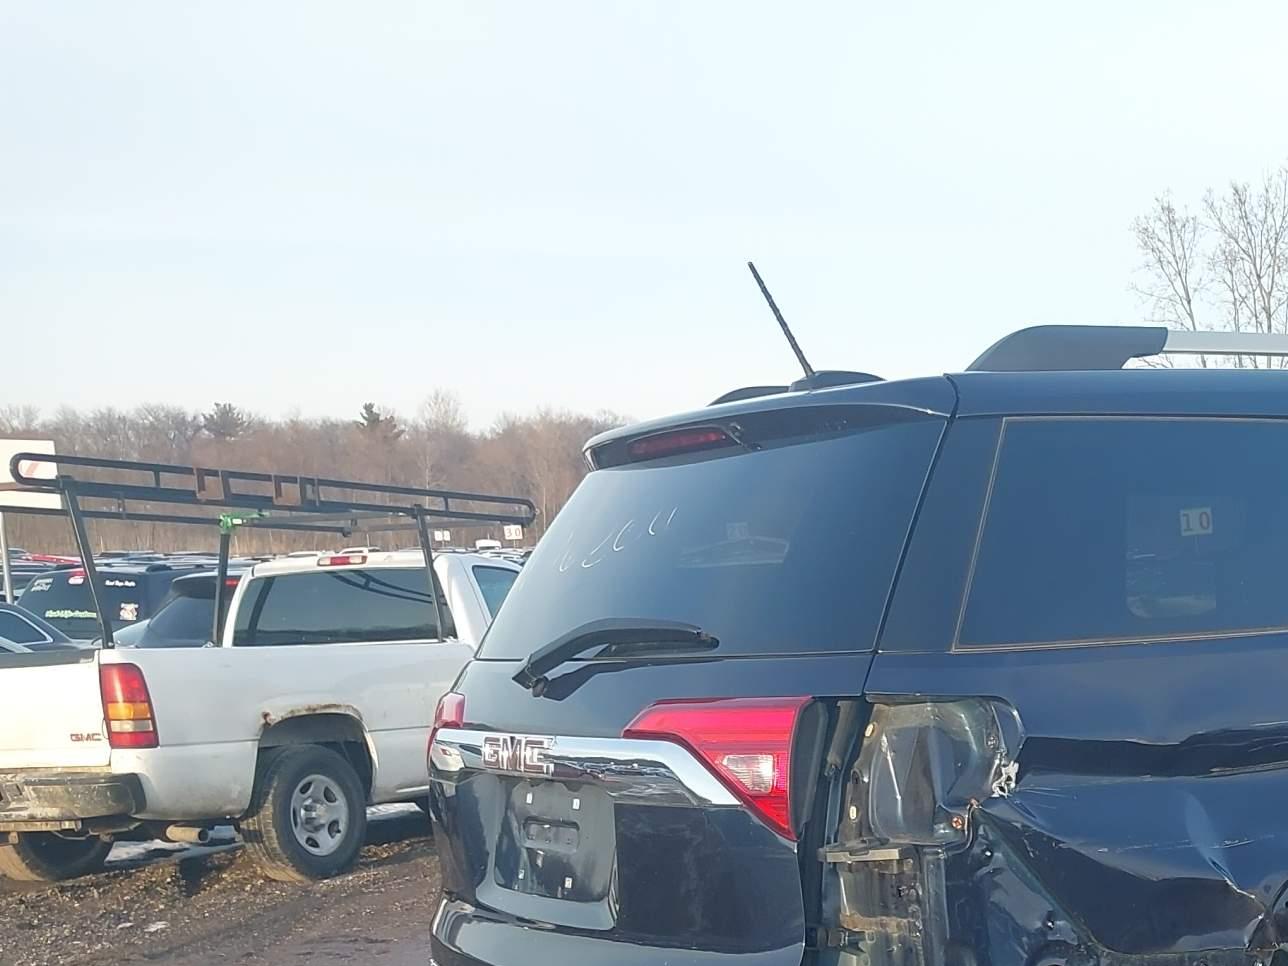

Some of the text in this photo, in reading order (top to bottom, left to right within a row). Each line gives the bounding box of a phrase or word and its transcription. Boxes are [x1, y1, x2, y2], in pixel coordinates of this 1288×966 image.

[505, 527, 521, 538] 30
[70, 733, 102, 742] GMC
[482, 735, 555, 775] GMC
